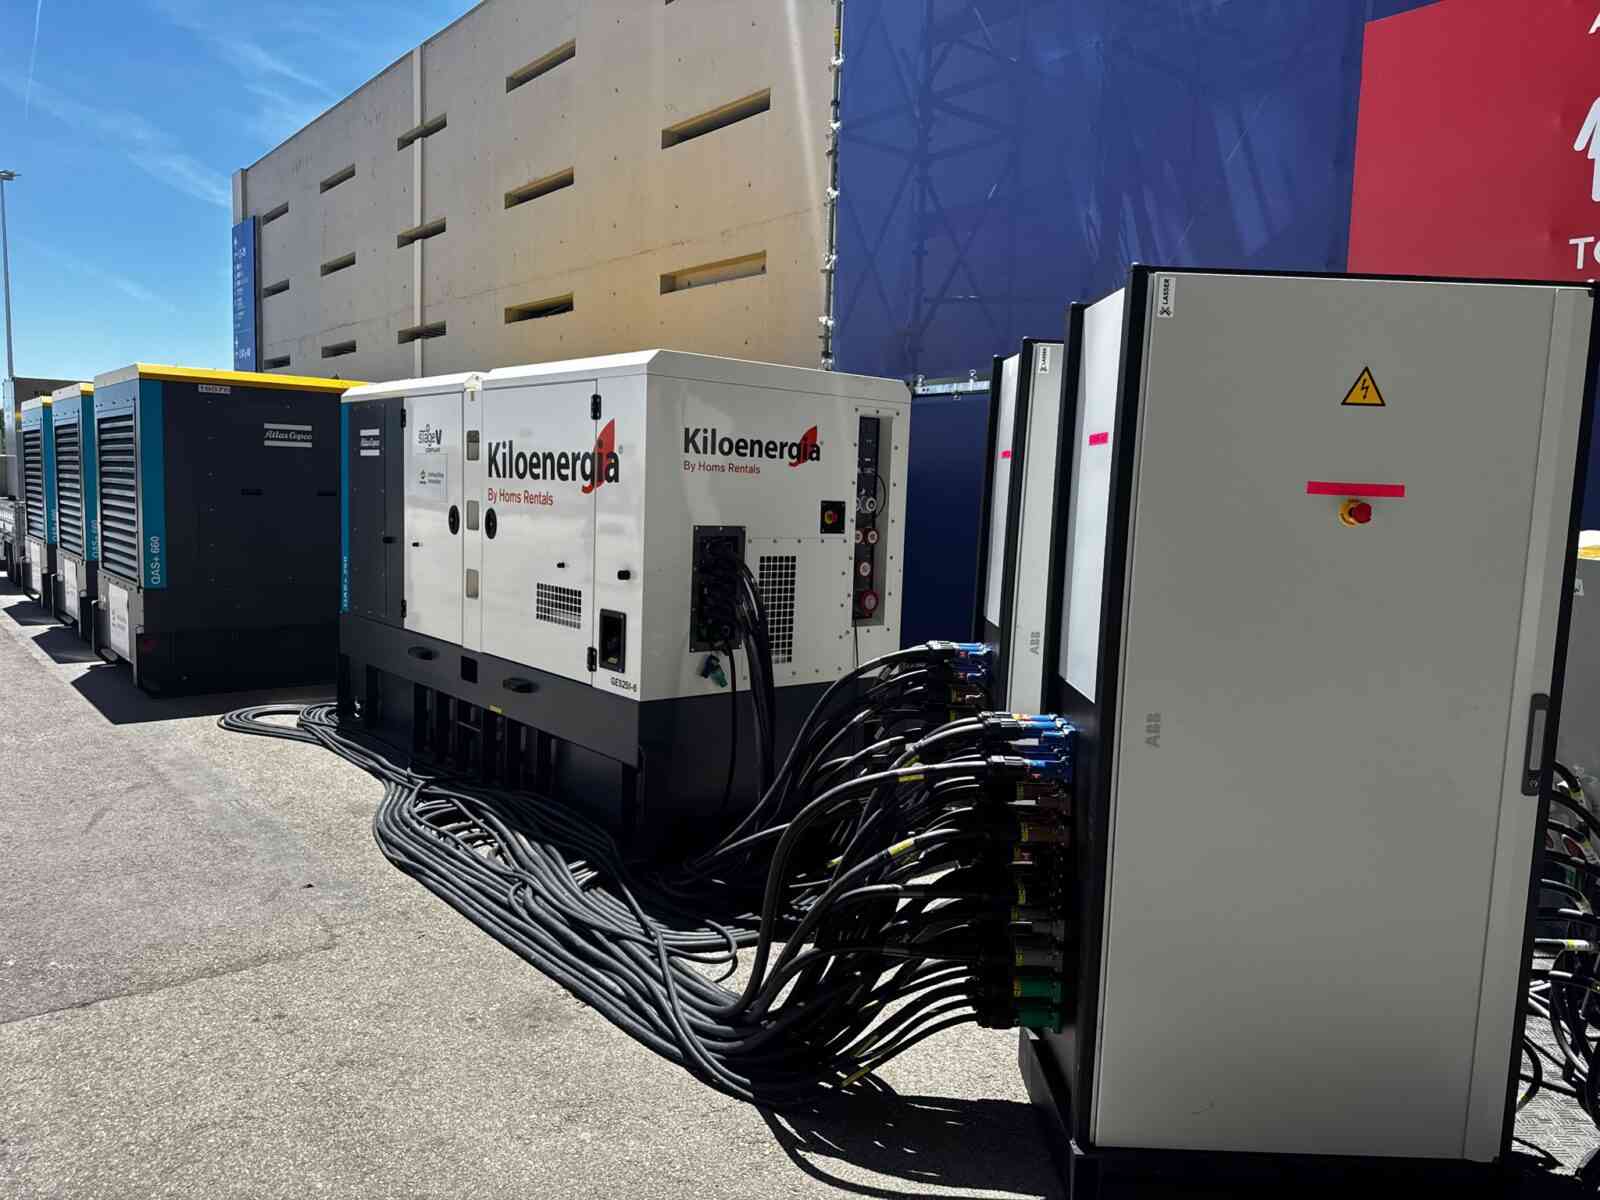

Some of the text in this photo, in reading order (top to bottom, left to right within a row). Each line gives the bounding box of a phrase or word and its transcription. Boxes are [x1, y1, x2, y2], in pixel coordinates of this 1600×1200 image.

[264, 431, 312, 440] Atlas Copco
[683, 427, 821, 467] Kiloenergia
[488, 440, 620, 494] Kiloenergia
[683, 460, 760, 474] By Homs Rentals
[488, 488, 554, 506] By Homs Rentals
[1030, 631, 1040, 655] ABB
[1145, 713, 1161, 748] ABB
